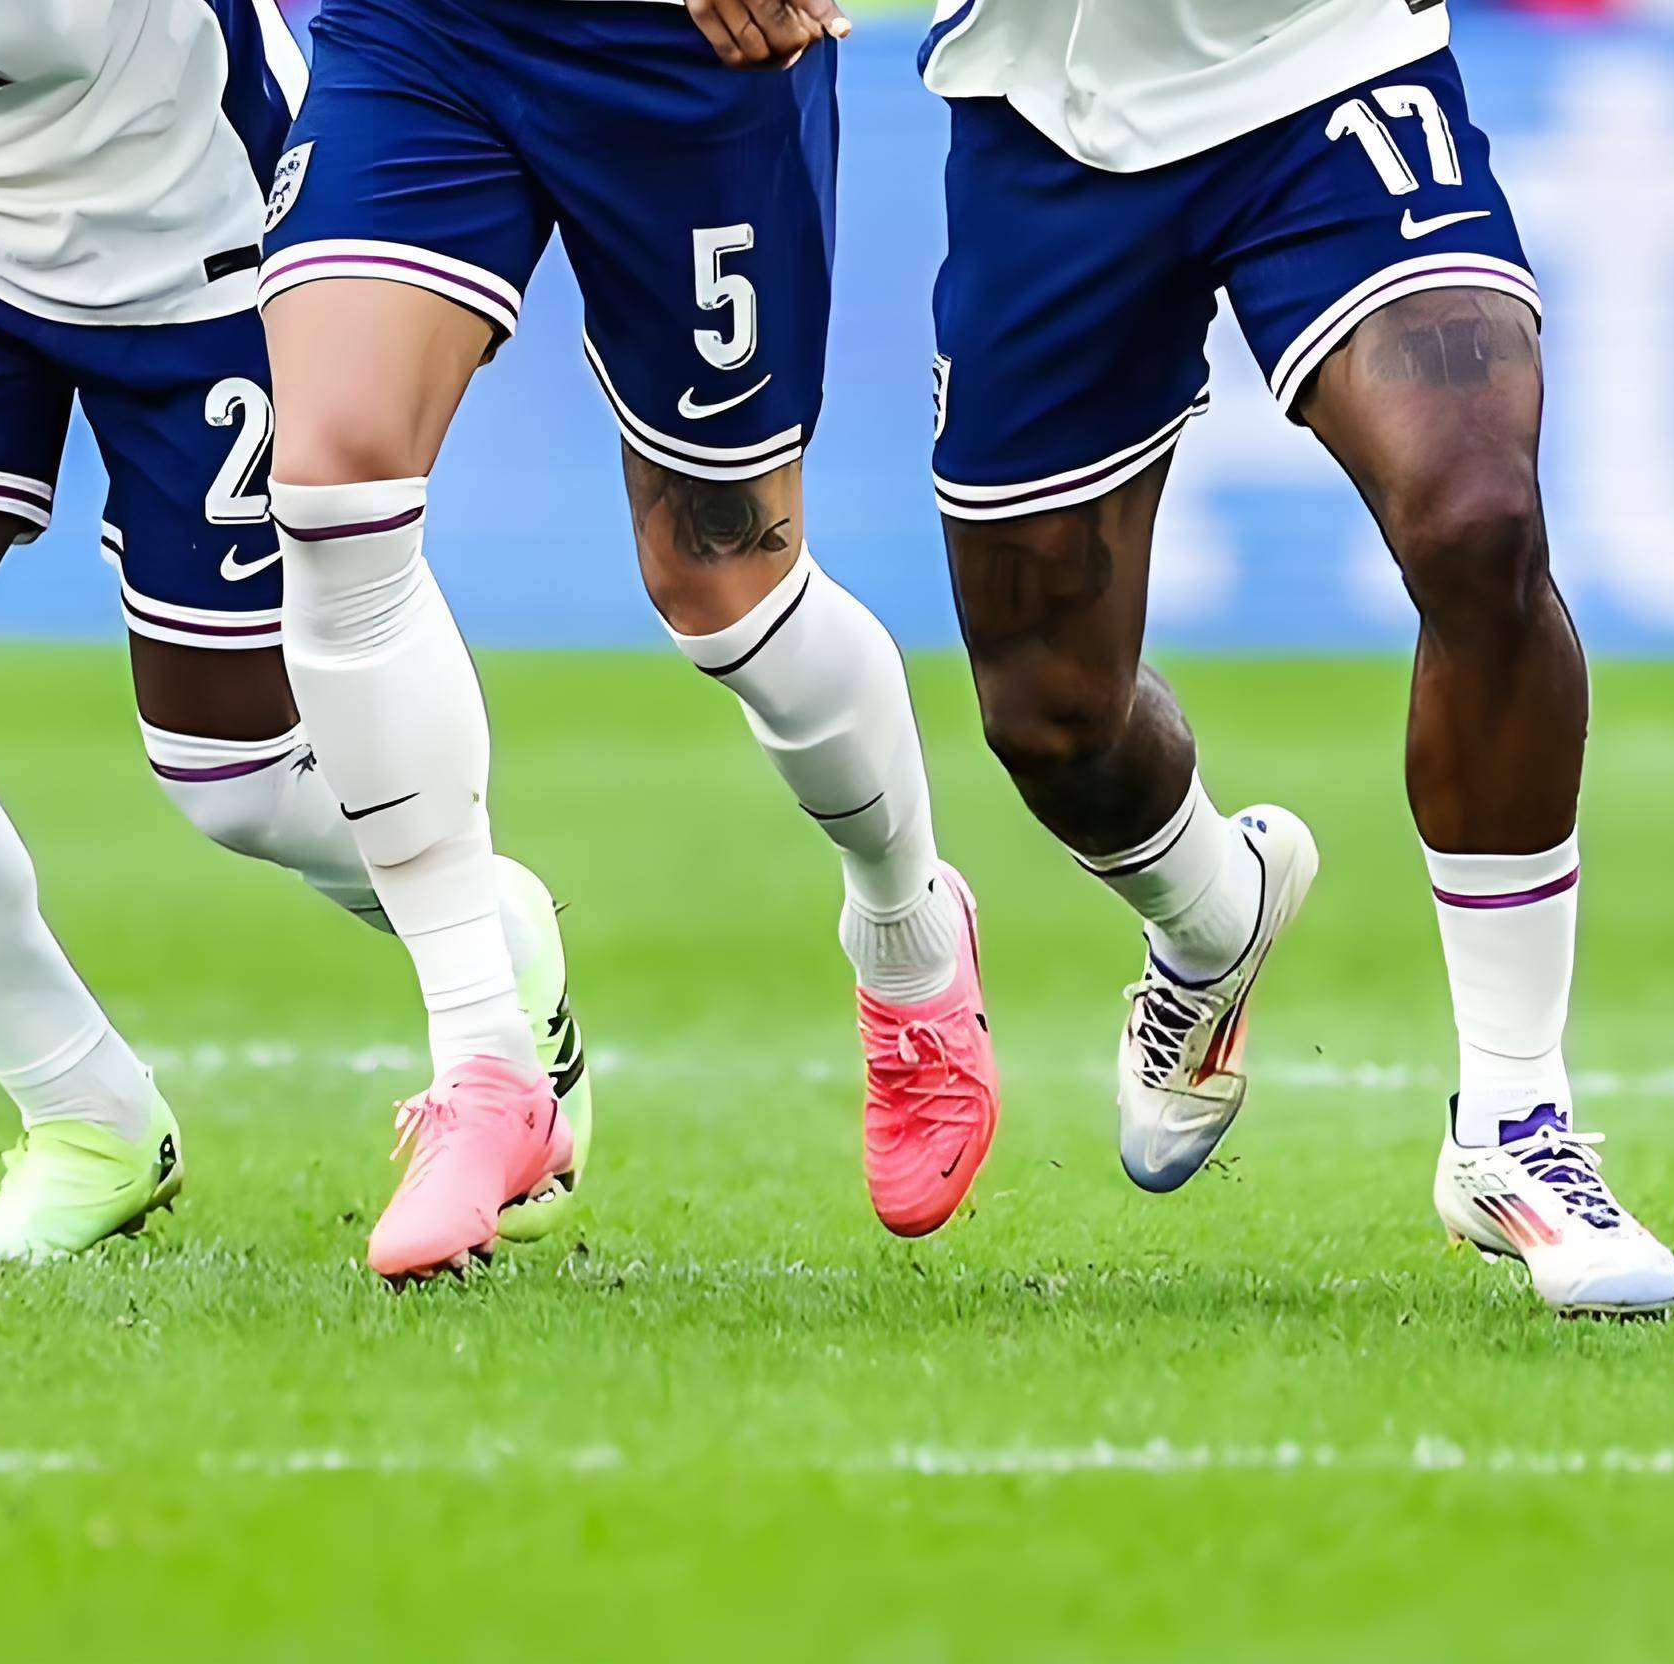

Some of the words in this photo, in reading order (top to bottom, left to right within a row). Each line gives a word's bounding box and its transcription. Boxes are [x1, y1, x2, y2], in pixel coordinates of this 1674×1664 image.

[1324, 84, 1463, 197] 17
[692, 222, 760, 370] 5
[204, 376, 275, 525] 2
